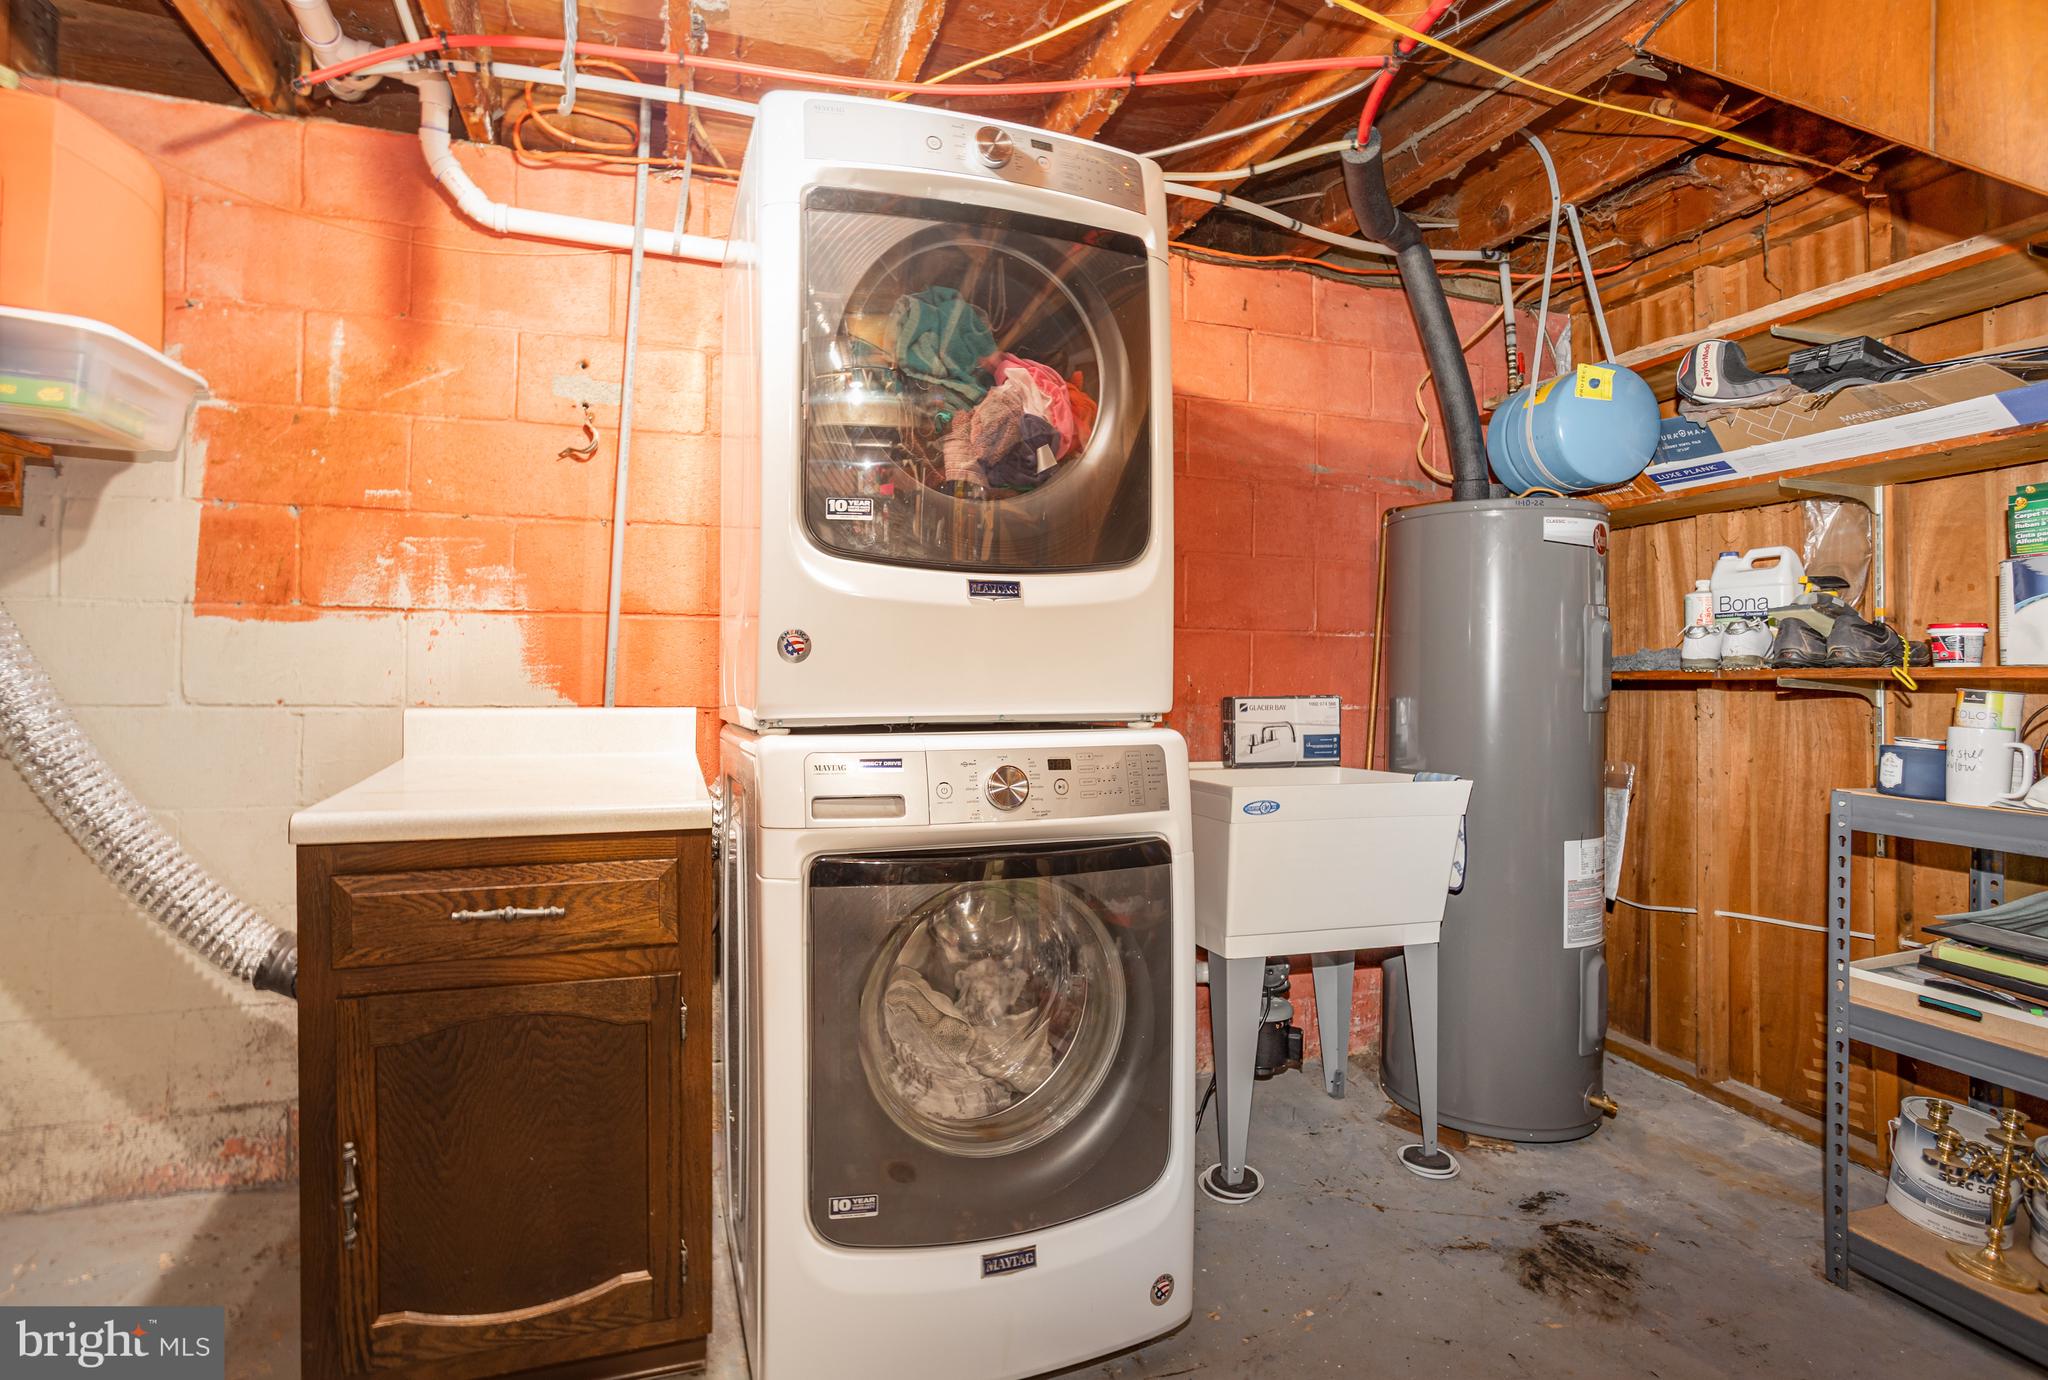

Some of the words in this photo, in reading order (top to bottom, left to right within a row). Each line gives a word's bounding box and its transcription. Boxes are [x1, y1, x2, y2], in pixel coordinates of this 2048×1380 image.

[1701, 343, 1713, 388] TaylorMade
[1840, 400, 1928, 423] MANNINGTON
[1656, 471, 1682, 480] LUXE
[1683, 465, 1719, 476] PLANK
[828, 499, 848, 512] 10
[2014, 510, 2041, 519] Carpet
[970, 583, 1019, 595] MAYTAG
[1720, 596, 1769, 612] Bona
[1249, 704, 1273, 712] GLACIER
[1959, 710, 2001, 721] OLOR
[814, 764, 847, 772] MAYTAG
[1938, 1172, 1974, 1192] SEC
[832, 1199, 852, 1212] 10
[985, 1252, 1035, 1273] MAYTAG
